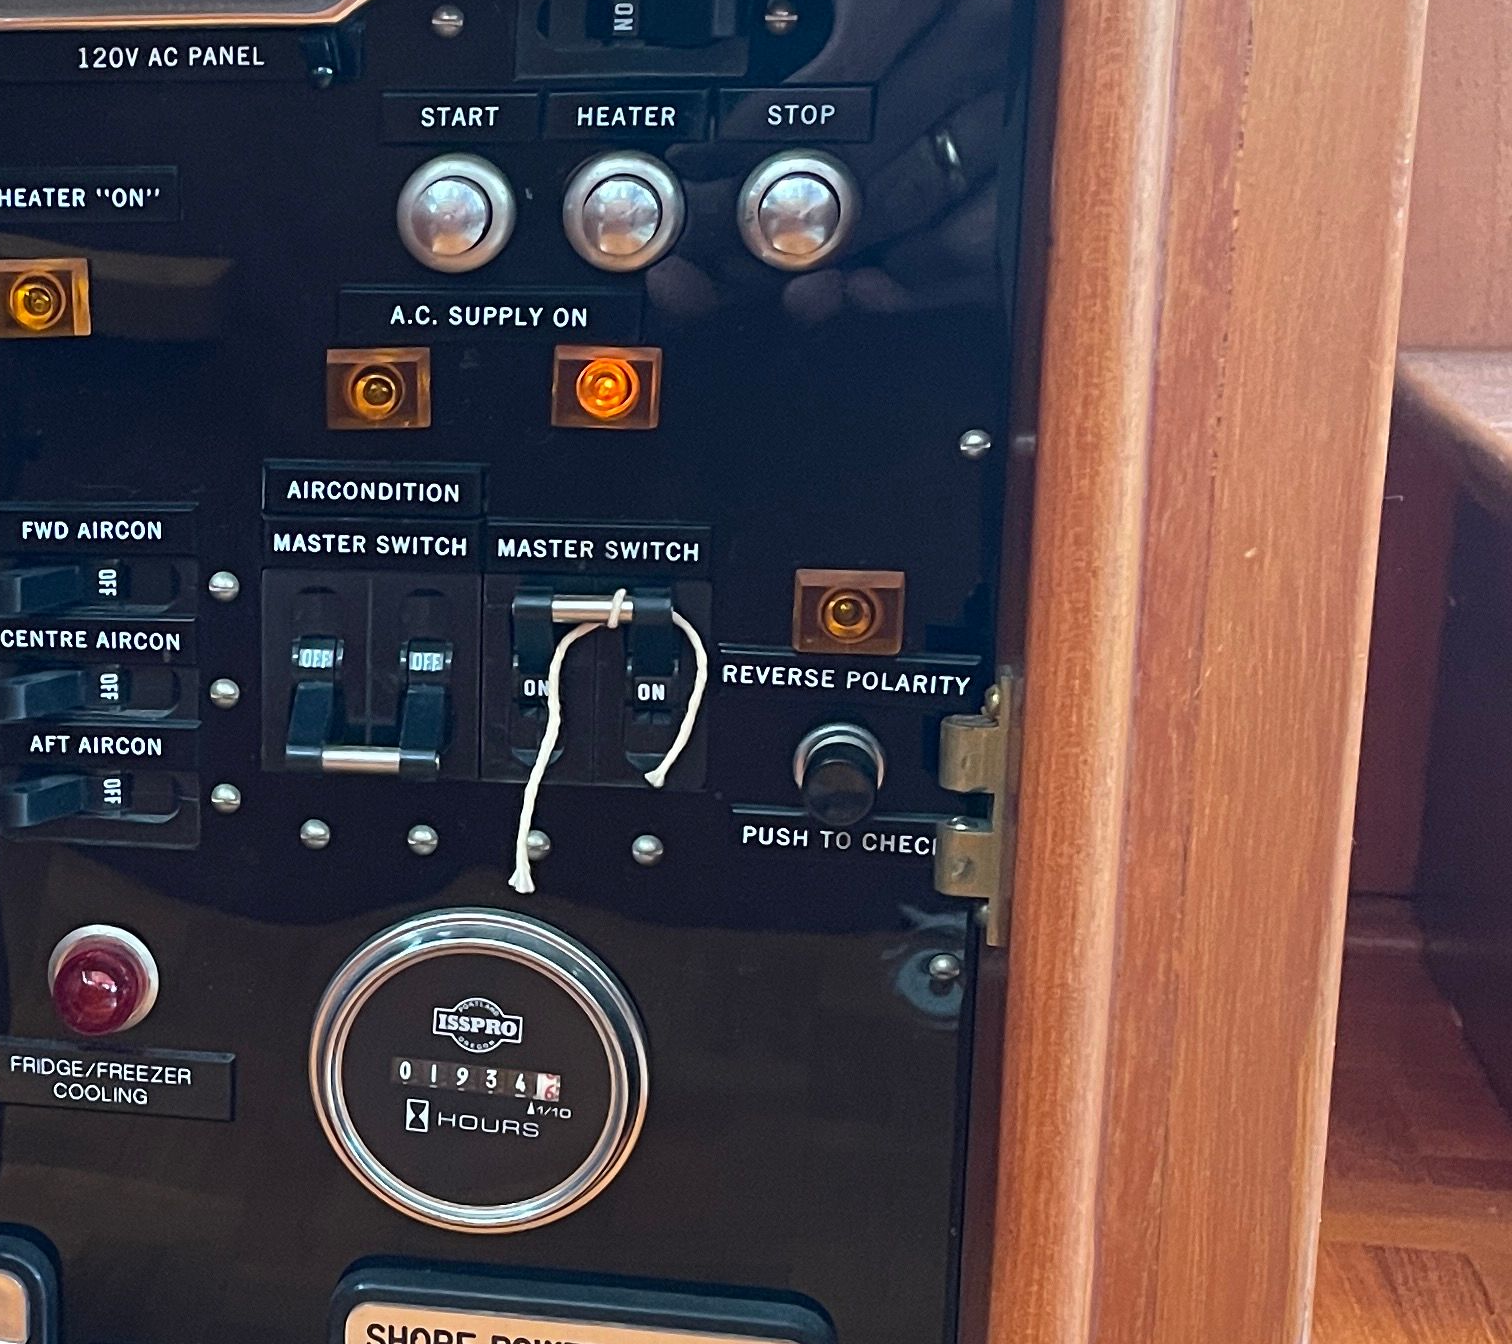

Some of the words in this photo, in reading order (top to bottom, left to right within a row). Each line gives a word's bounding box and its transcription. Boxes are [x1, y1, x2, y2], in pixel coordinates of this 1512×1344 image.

[614, 2, 634, 32] ON
[77, 47, 139, 69] 120V
[148, 47, 178, 67] AC
[189, 46, 265, 66] PANEL
[420, 106, 499, 128] START
[577, 106, 676, 128] HEATER
[767, 104, 836, 127] STOP
[390, 306, 438, 327] A.C.
[449, 306, 542, 328] SUPPLY
[552, 306, 588, 328] ON
[287, 480, 460, 503] AIRCONDITION
[22, 521, 69, 540] FWD
[77, 521, 162, 540] AIRCON
[273, 533, 366, 554] MASTER
[376, 535, 467, 557] SWITCH
[498, 539, 593, 559] MASTER
[605, 541, 699, 562] SWITCH
[98, 569, 117, 596] OFF
[0, 630, 87, 648] CENTRE
[96, 631, 180, 651] AIRCON
[301, 650, 332, 668] OFF
[411, 653, 442, 671] OFF
[100, 673, 119, 700] OFF
[524, 679, 550, 698] ON
[722, 664, 835, 689] REVERSE
[846, 671, 971, 696] POLARITY
[637, 684, 665, 701] ON
[30, 735, 69, 754] AFT
[78, 736, 162, 756] AIRCON
[103, 778, 122, 805] OFF
[742, 825, 808, 847] PUSH
[820, 830, 851, 850] TO
[862, 833, 937, 856] CHEC
[438, 1013, 517, 1037] ISSPRO
[10, 1055, 192, 1086] FRIDGE/FREEZER
[53, 1082, 149, 1105] COOLING
[537, 1106, 572, 1119] 1/10
[438, 1111, 540, 1138] HOURS
